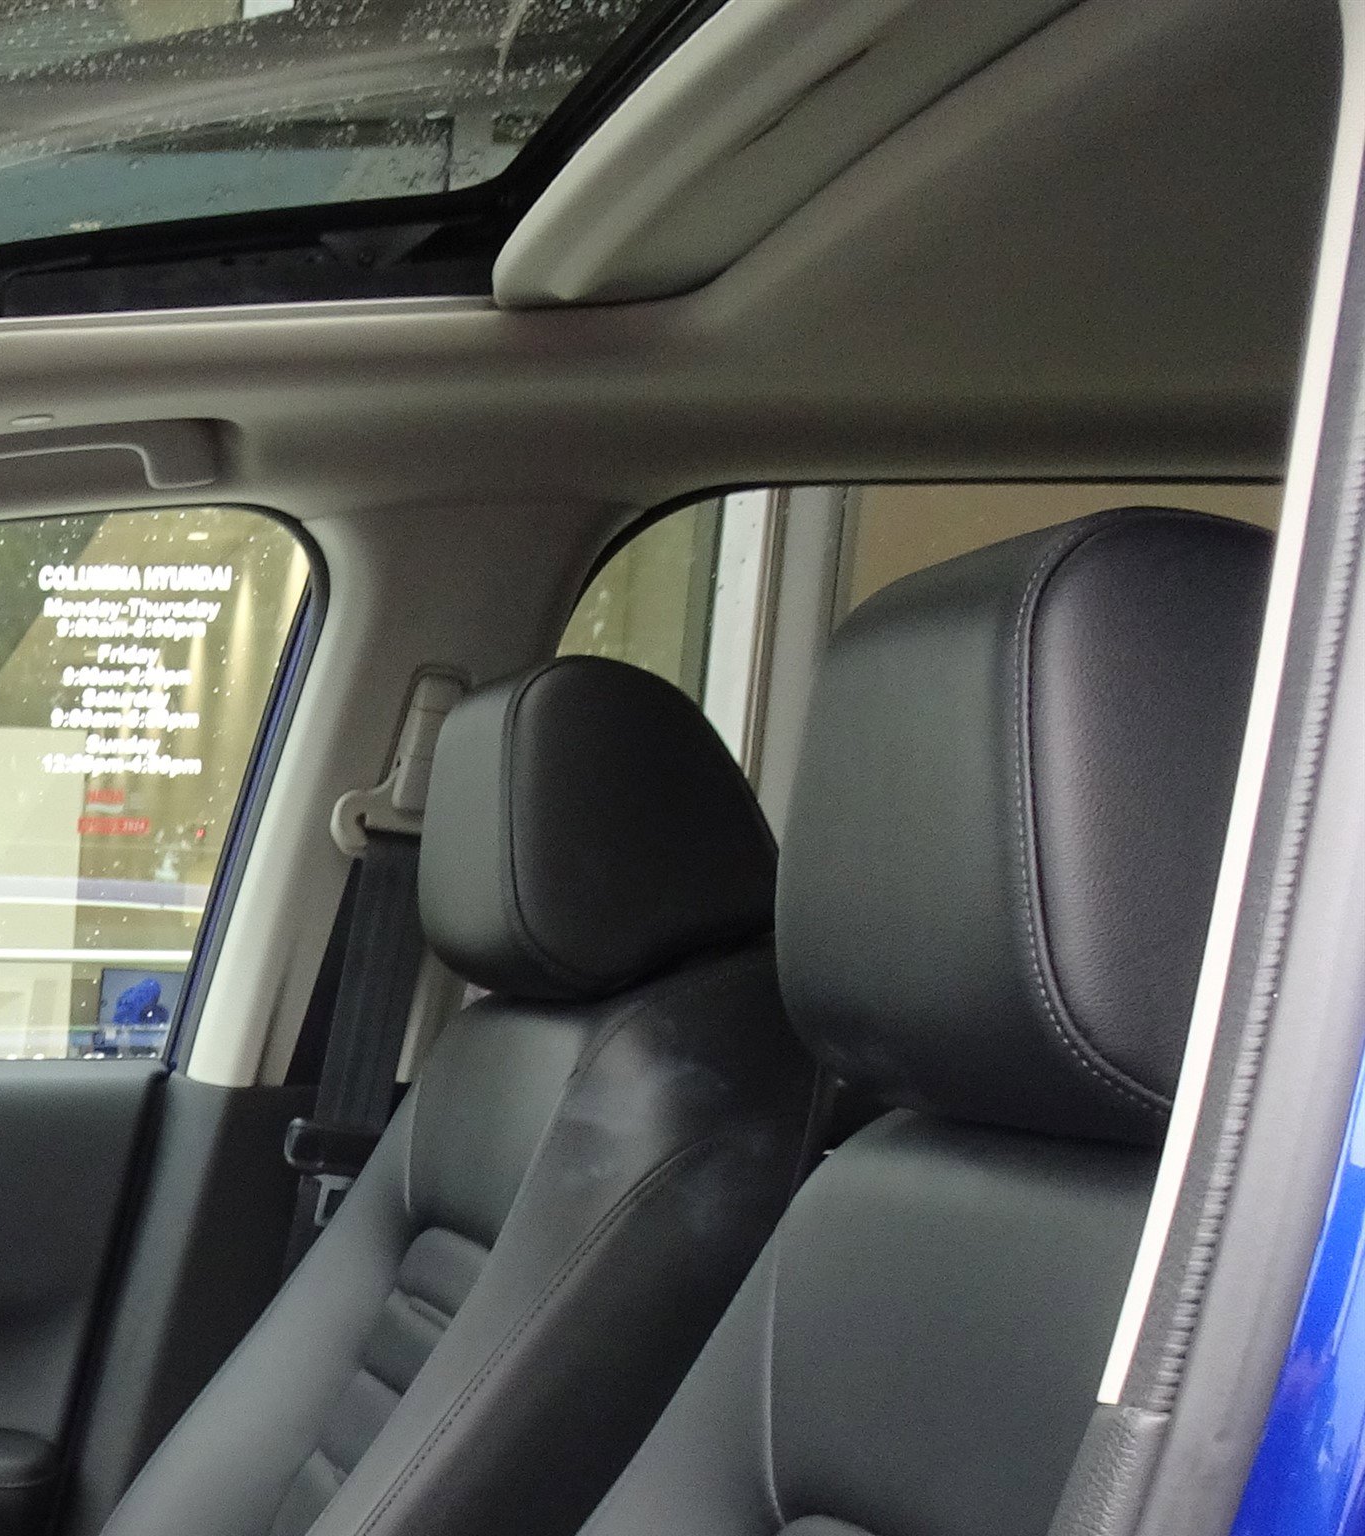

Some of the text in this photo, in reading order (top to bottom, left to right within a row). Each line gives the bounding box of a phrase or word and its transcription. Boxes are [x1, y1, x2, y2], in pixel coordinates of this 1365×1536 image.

[38, 564, 233, 591] COLUMBIA HYUNDAI
[43, 597, 221, 622] Monday-Thursday
[97, 644, 160, 669] Friday
[81, 687, 170, 710] Saturday
[86, 733, 161, 756] Sunday
